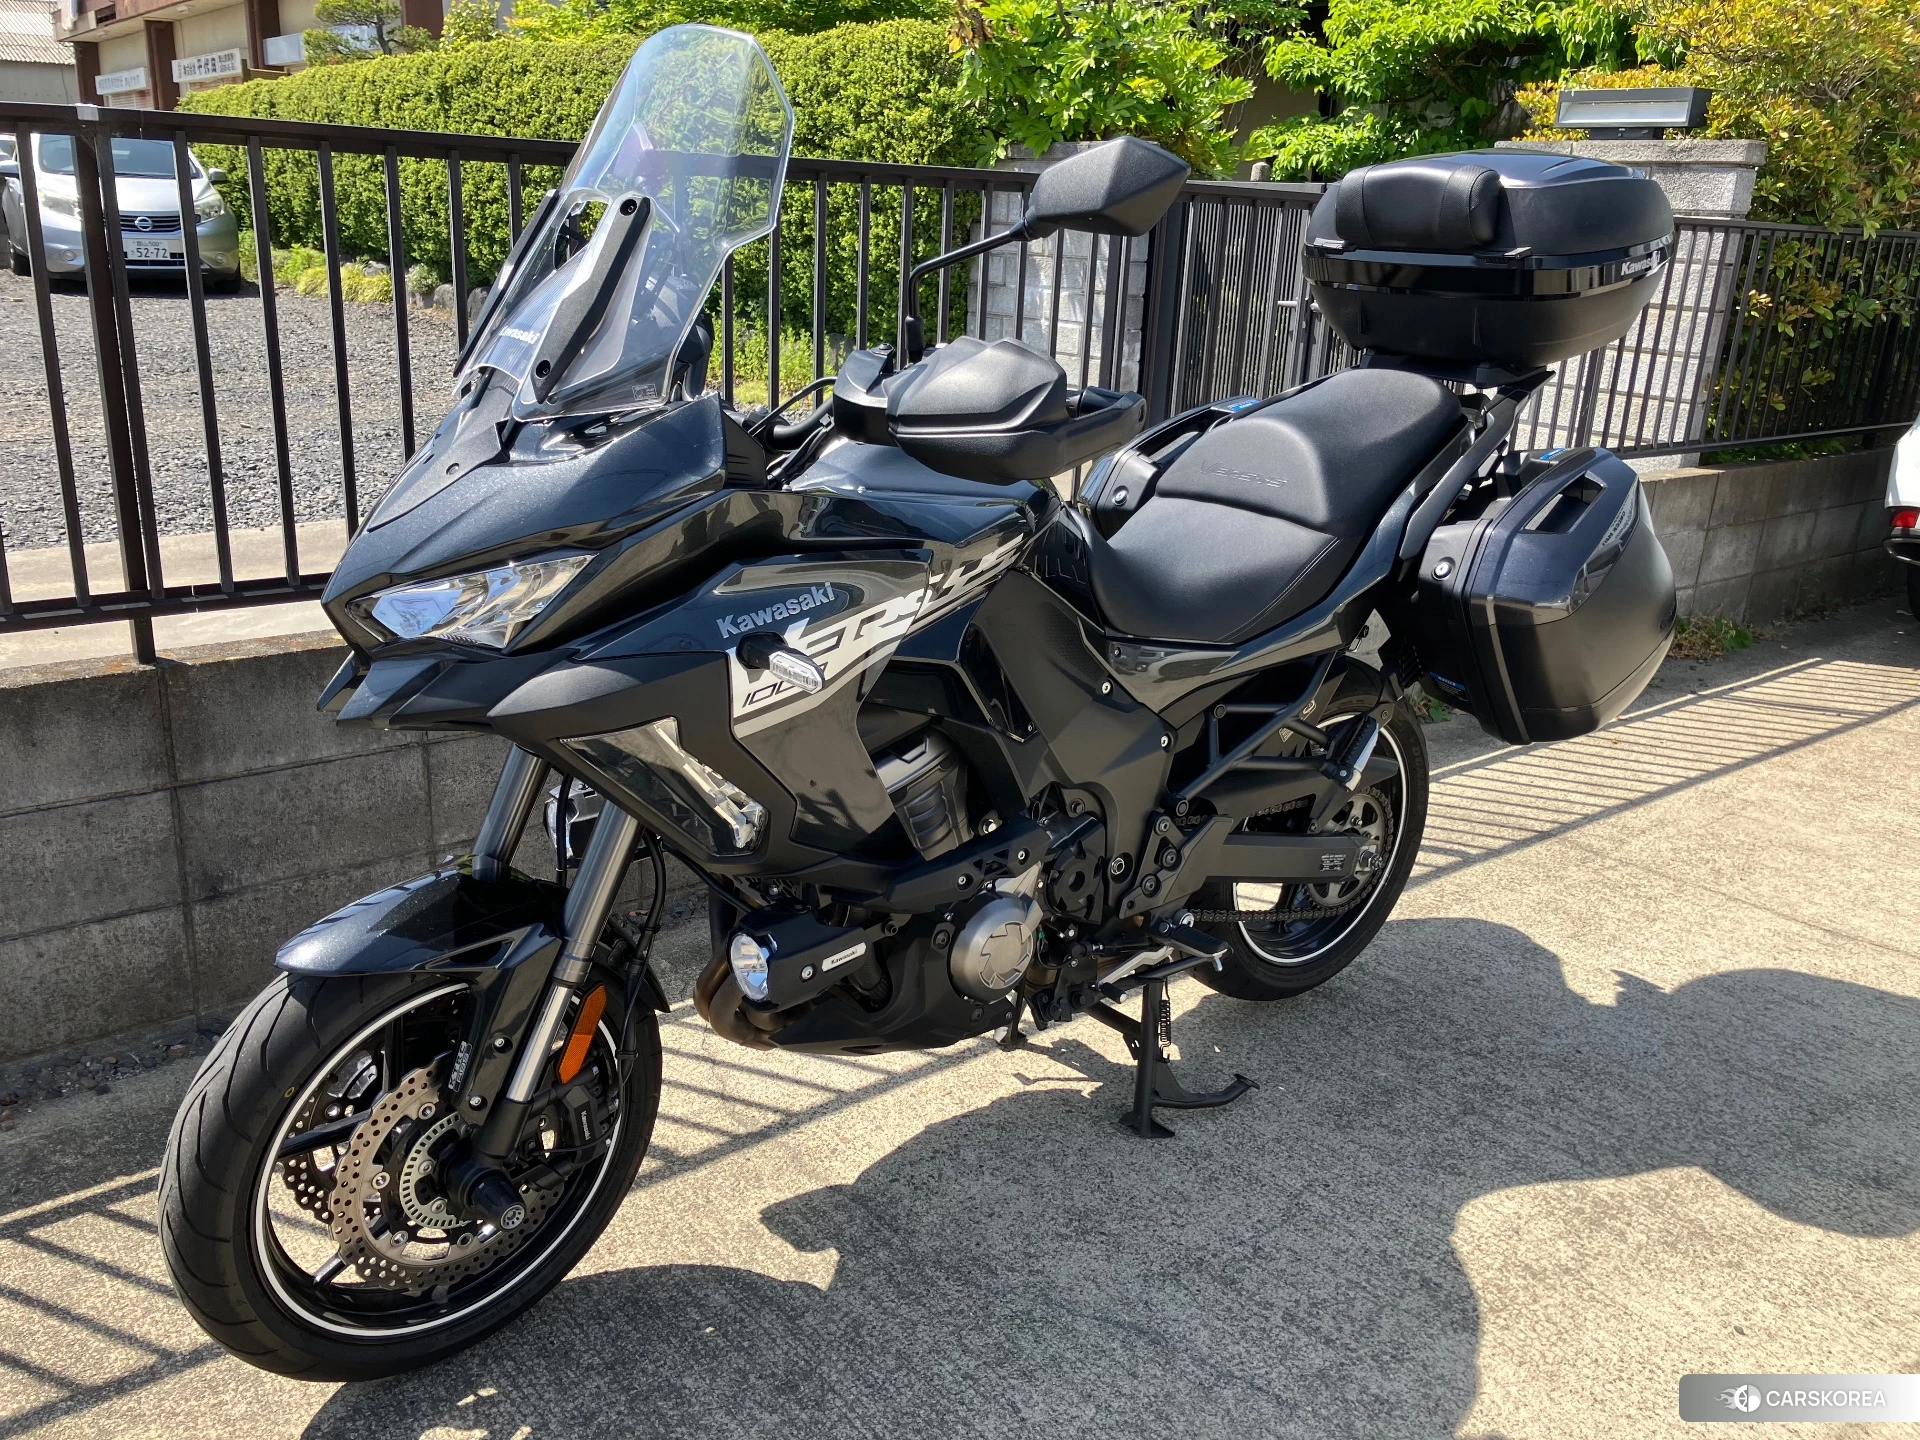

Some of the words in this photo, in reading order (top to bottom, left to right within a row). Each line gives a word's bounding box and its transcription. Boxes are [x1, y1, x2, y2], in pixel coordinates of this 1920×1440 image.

[136, 247, 168, 259] 52-72
[716, 581, 836, 639] Kawasaki
[831, 949, 858, 965] Kawasaki
[580, 1110, 591, 1141] Kawasaki
